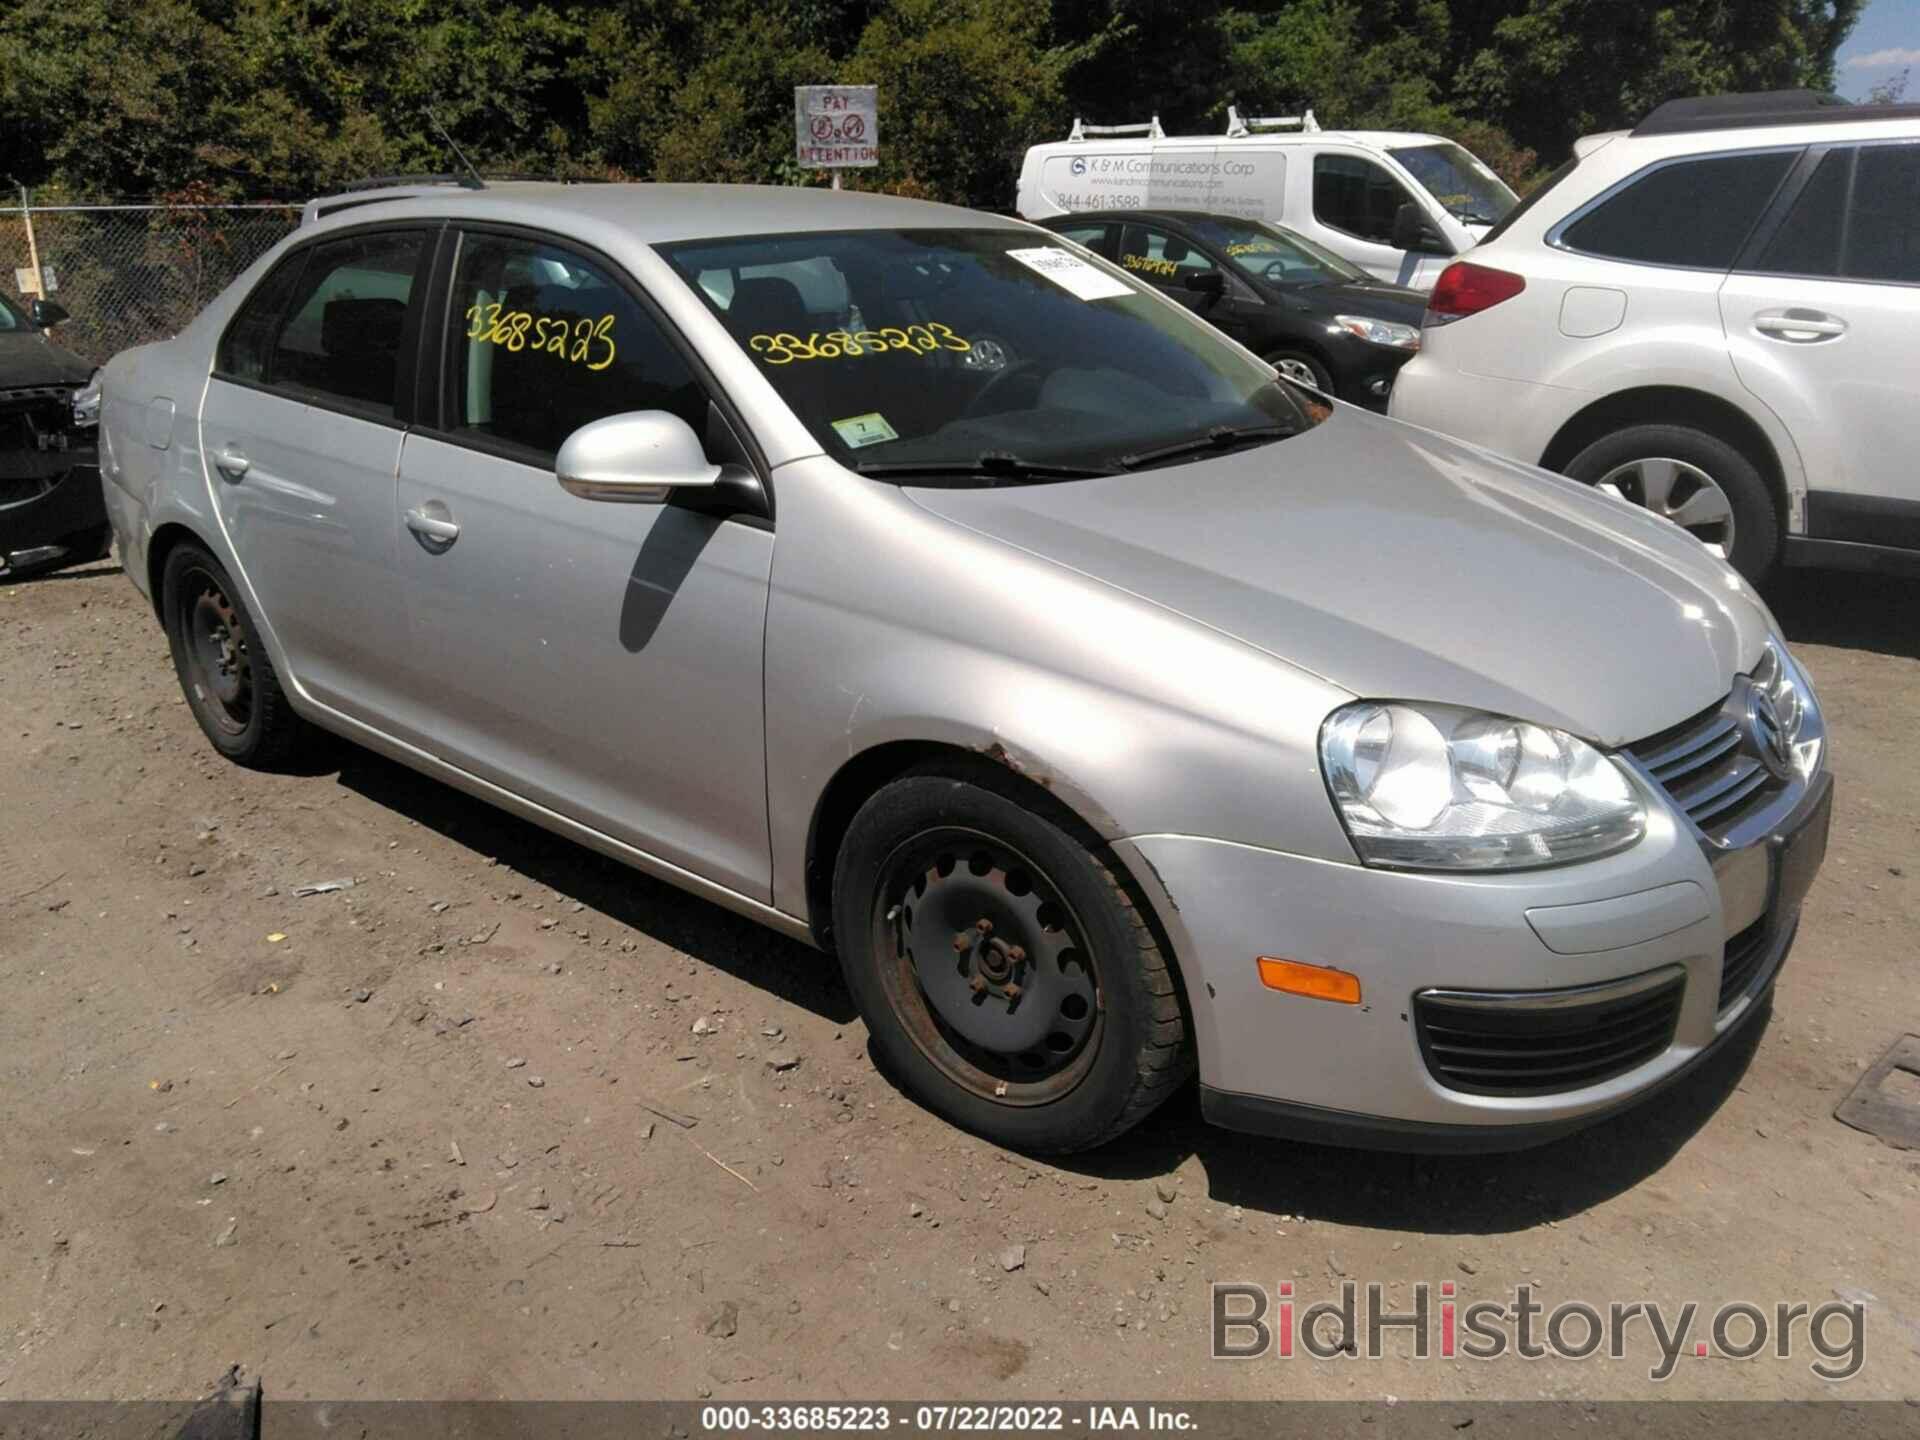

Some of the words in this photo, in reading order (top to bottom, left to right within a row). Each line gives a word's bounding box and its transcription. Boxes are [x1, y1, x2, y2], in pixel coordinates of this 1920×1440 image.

[823, 95, 849, 110] PAY
[1090, 159, 1098, 171] K
[1112, 159, 1125, 171] M
[1126, 159, 1221, 175] Communications
[1223, 160, 1255, 176] Corp
[466, 303, 615, 370] 33685223
[750, 322, 971, 364] 33685223
